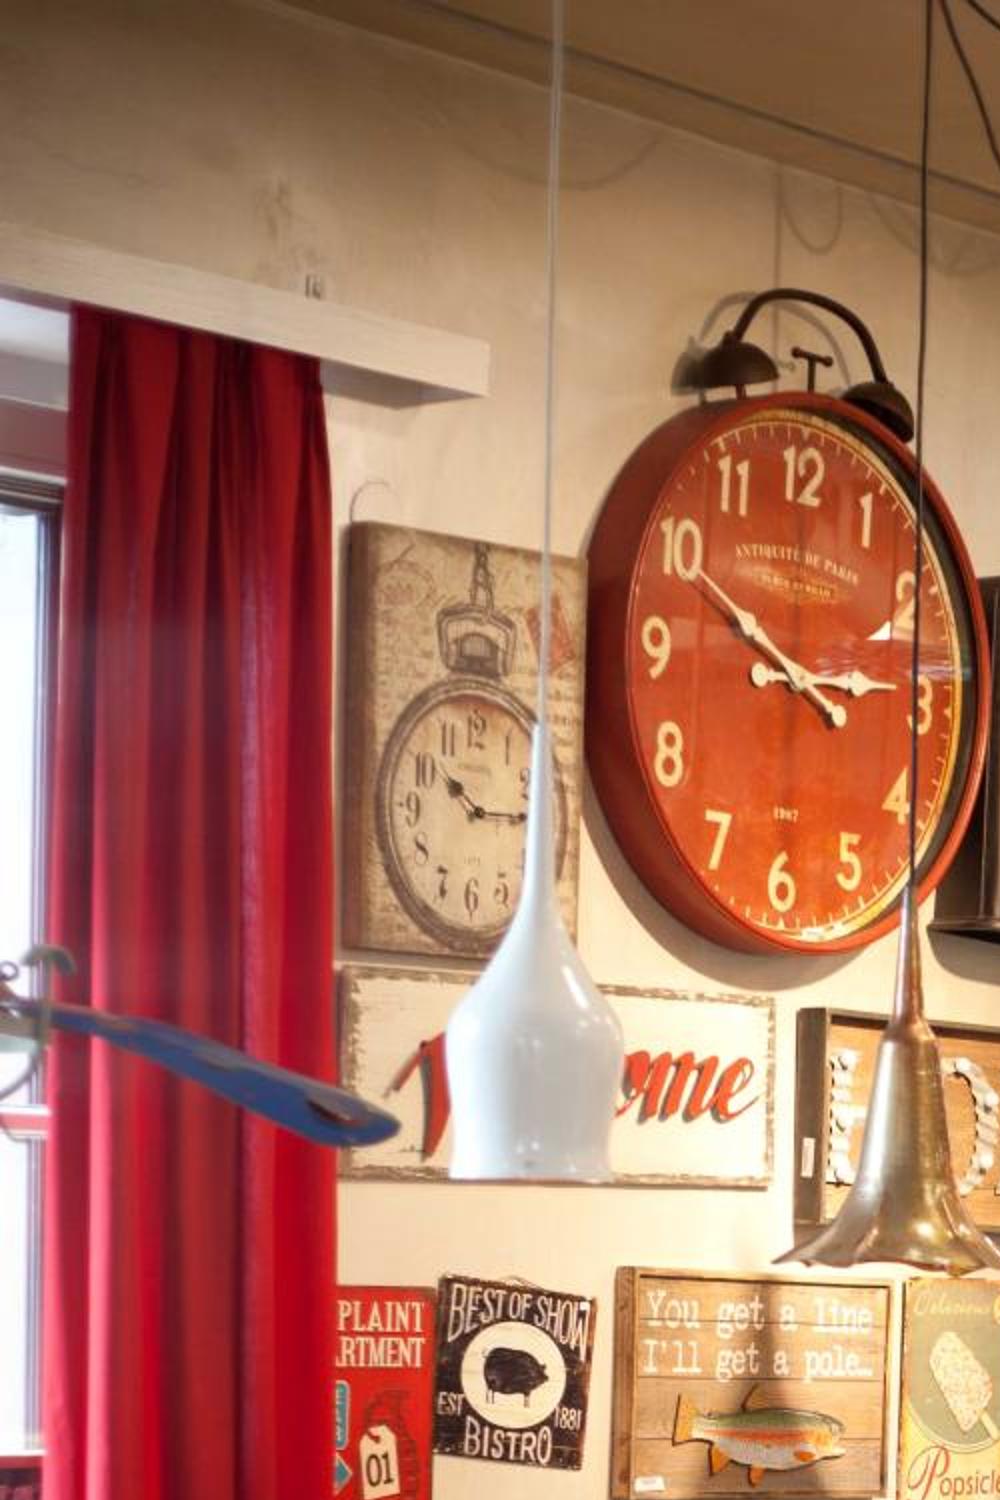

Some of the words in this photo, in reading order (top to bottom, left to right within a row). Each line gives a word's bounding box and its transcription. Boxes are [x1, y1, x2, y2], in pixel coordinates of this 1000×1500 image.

[719, 455, 750, 517] 11
[784, 446, 824, 507] 12
[860, 493, 872, 547] 1
[661, 516, 701, 582] 10
[896, 571, 918, 630] 2
[641, 616, 671, 678] 9
[467, 710, 486, 750] 12
[907, 674, 932, 734] 3
[441, 722, 455, 757] 11
[654, 722, 683, 787] 8
[415, 752, 436, 788] 10
[883, 768, 910, 824] 4
[406, 791, 421, 828] 9
[414, 832, 429, 866] 8
[705, 810, 732, 870] 7
[835, 832, 861, 890] 5
[437, 865, 448, 899] 7
[464, 877, 479, 922] 6
[767, 853, 795, 913] 6
[448, 1283, 506, 1342] BEST
[509, 1292, 532, 1320] OF
[534, 1295, 590, 1362] SHOW
[646, 1289, 701, 1329] You
[717, 1295, 764, 1340] get
[779, 1302, 798, 1331] a
[812, 1297, 873, 1334] line
[336, 1335, 426, 1368] RTMENT
[643, 1338, 702, 1374] I'll
[716, 1341, 760, 1383] get
[773, 1350, 789, 1376] a
[437, 1391, 465, 1416] EST
[554, 1407, 582, 1430] 1881
[366, 1452, 394, 1487] 01
